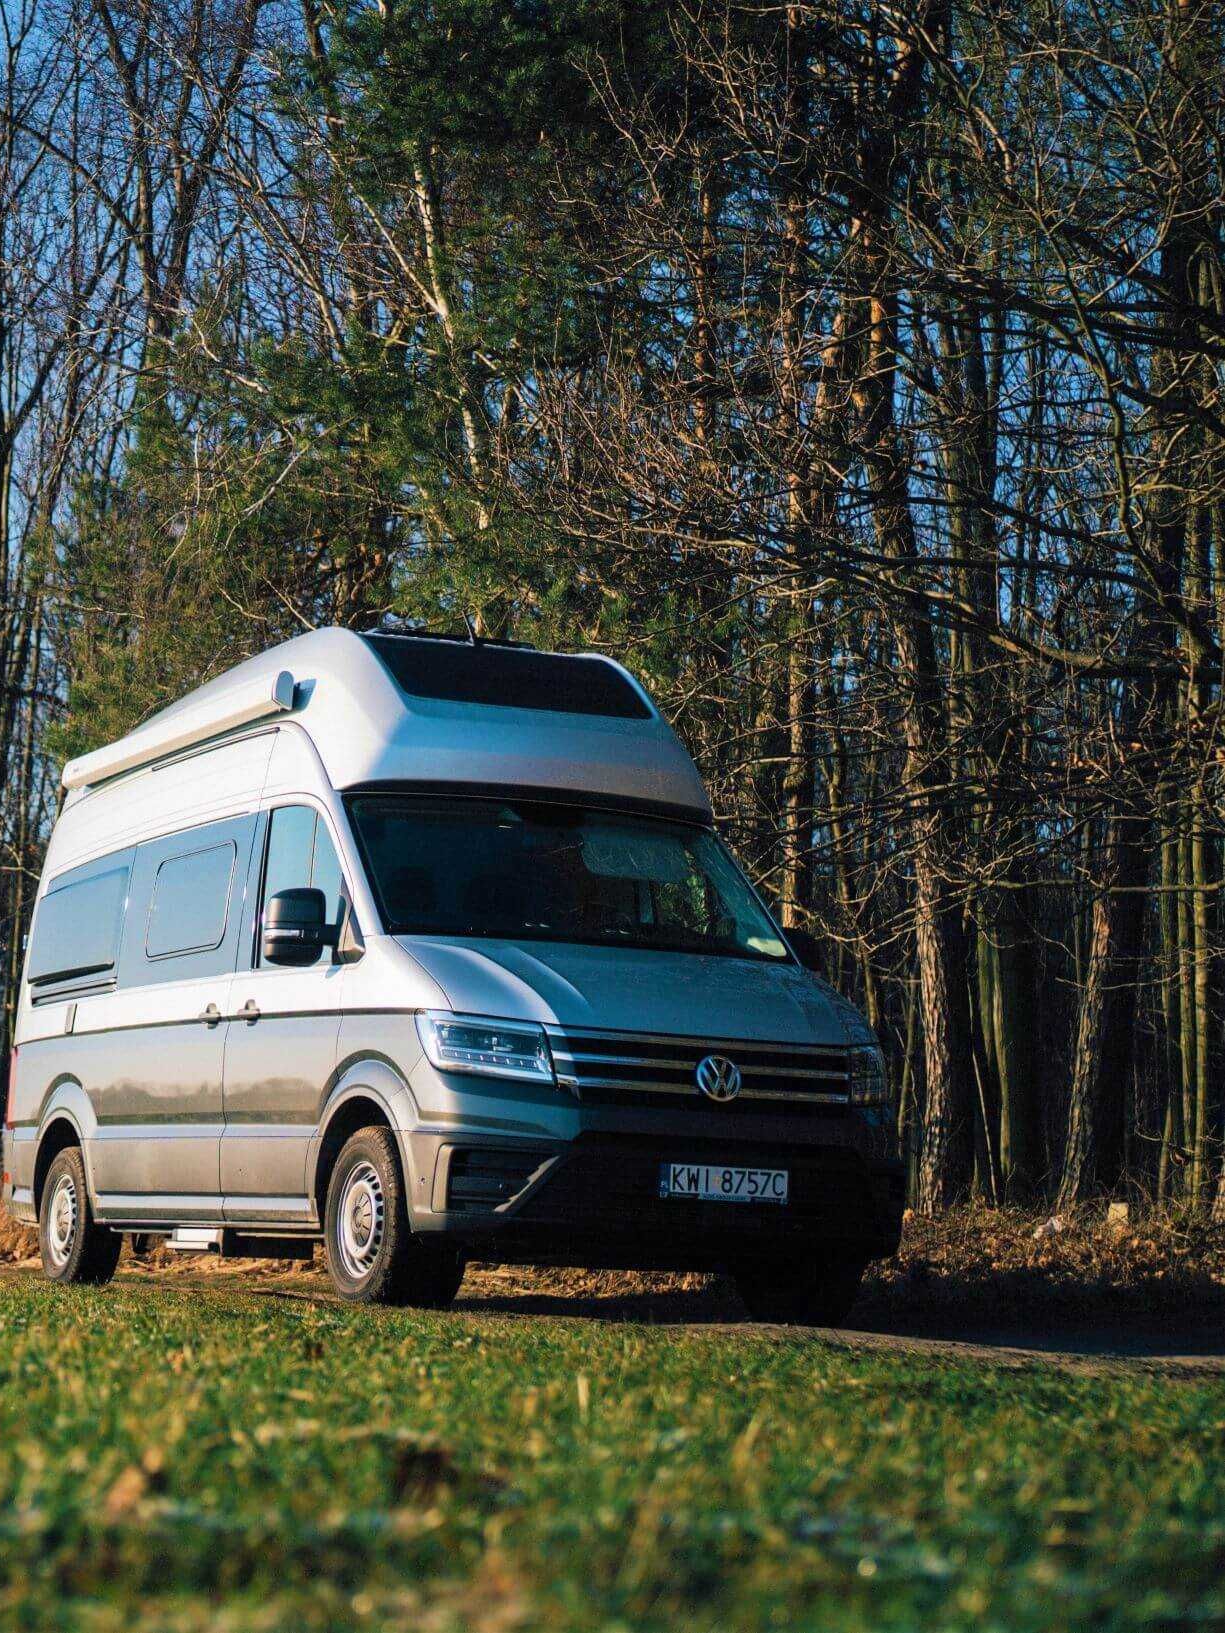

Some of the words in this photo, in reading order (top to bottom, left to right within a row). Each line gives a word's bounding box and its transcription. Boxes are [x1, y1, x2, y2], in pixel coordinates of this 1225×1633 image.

[698, 1056, 740, 1101] VW
[672, 1166, 709, 1193] KWI
[721, 1169, 785, 1197] 8757C
